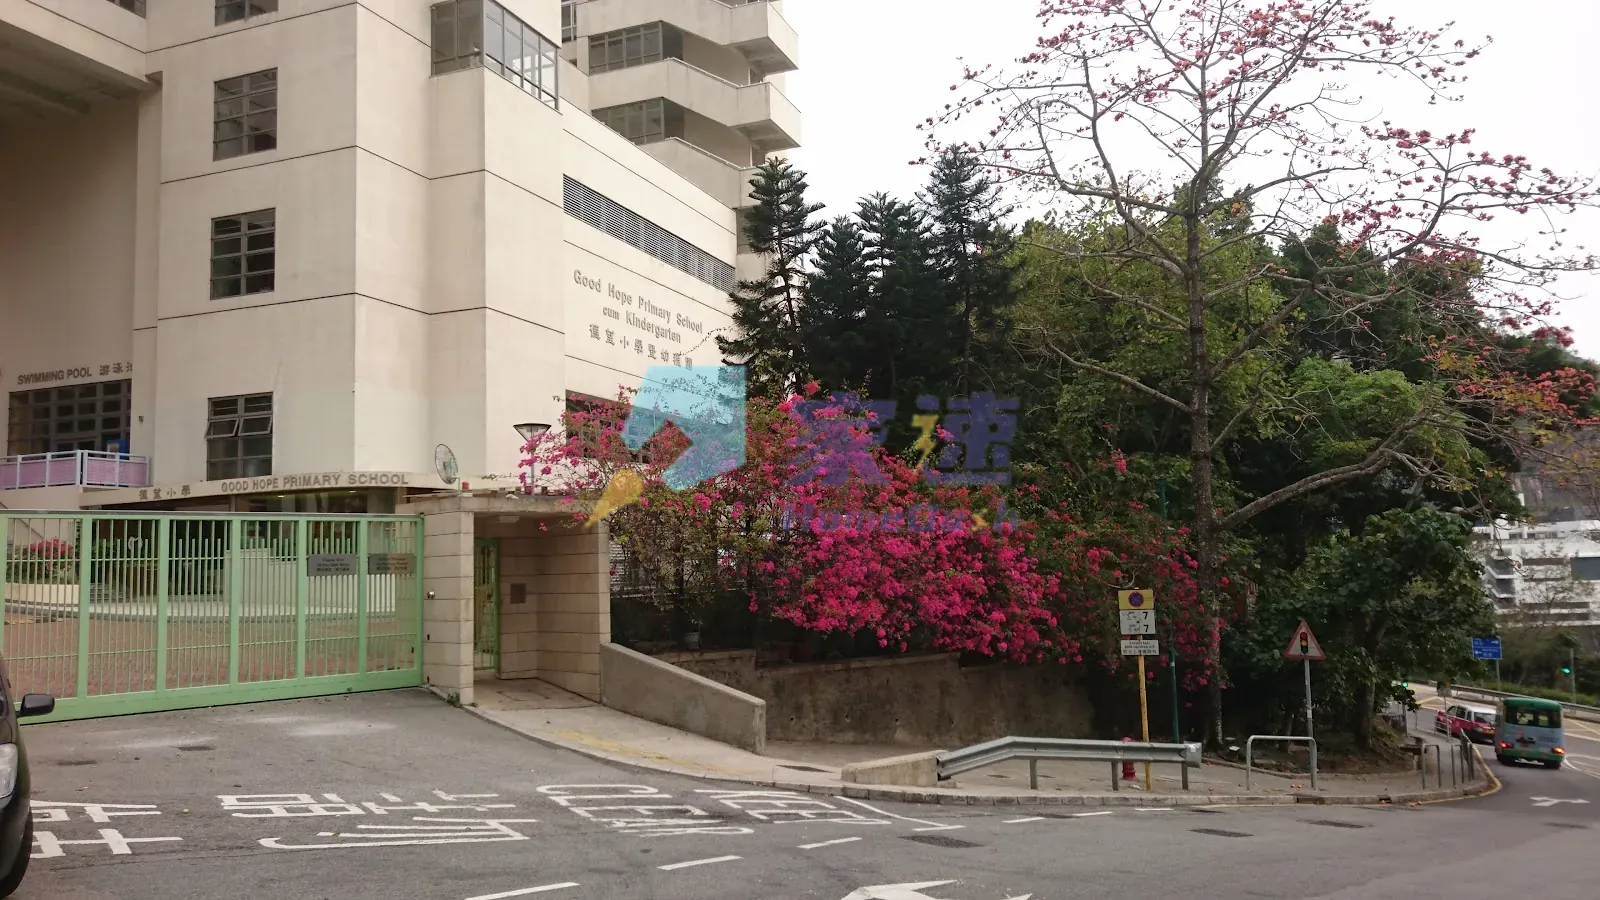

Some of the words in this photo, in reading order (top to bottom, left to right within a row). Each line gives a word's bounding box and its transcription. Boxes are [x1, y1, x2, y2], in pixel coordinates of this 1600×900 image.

[573, 268, 602, 293] Good
[608, 282, 633, 306] Hope
[638, 295, 672, 323] Primary
[676, 311, 703, 334] School
[602, 306, 620, 321] cum
[625, 310, 682, 344] Kindergarten
[17, 370, 65, 385] SWIMMING
[66, 366, 92, 380] POOL
[220, 480, 249, 493] GOOD
[252, 478, 279, 490] HOPE
[283, 474, 342, 488] PRIMARY
[347, 473, 409, 485] SCHOOL
[1142, 612, 1148, 620] 7
[1143, 624, 1149, 632] 7
[535, 783, 755, 837] CLEAR
[693, 788, 892, 825] KEEP
